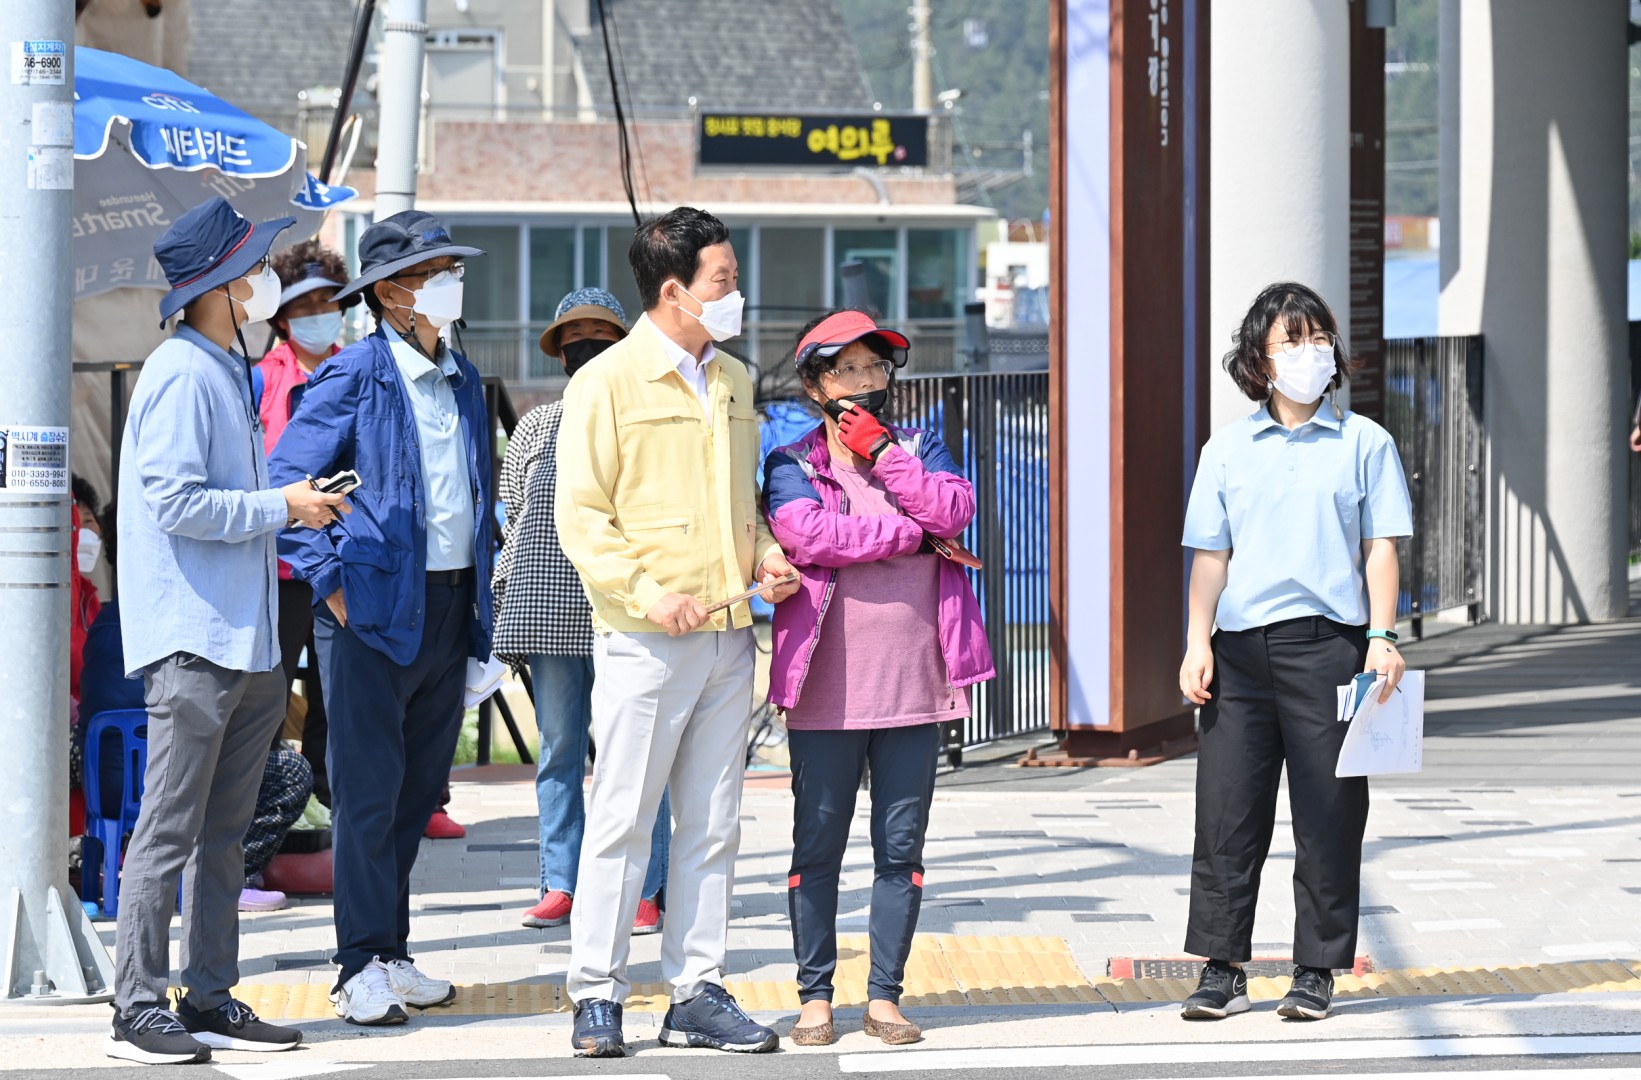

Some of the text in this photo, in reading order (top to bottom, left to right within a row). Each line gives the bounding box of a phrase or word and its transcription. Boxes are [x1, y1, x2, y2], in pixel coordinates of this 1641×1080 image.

[1147, 0, 1160, 97] 거장
[141, 93, 201, 115] citi
[159, 126, 253, 167] 씨티카드
[11, 431, 67, 443] 벽시계 출장수리
